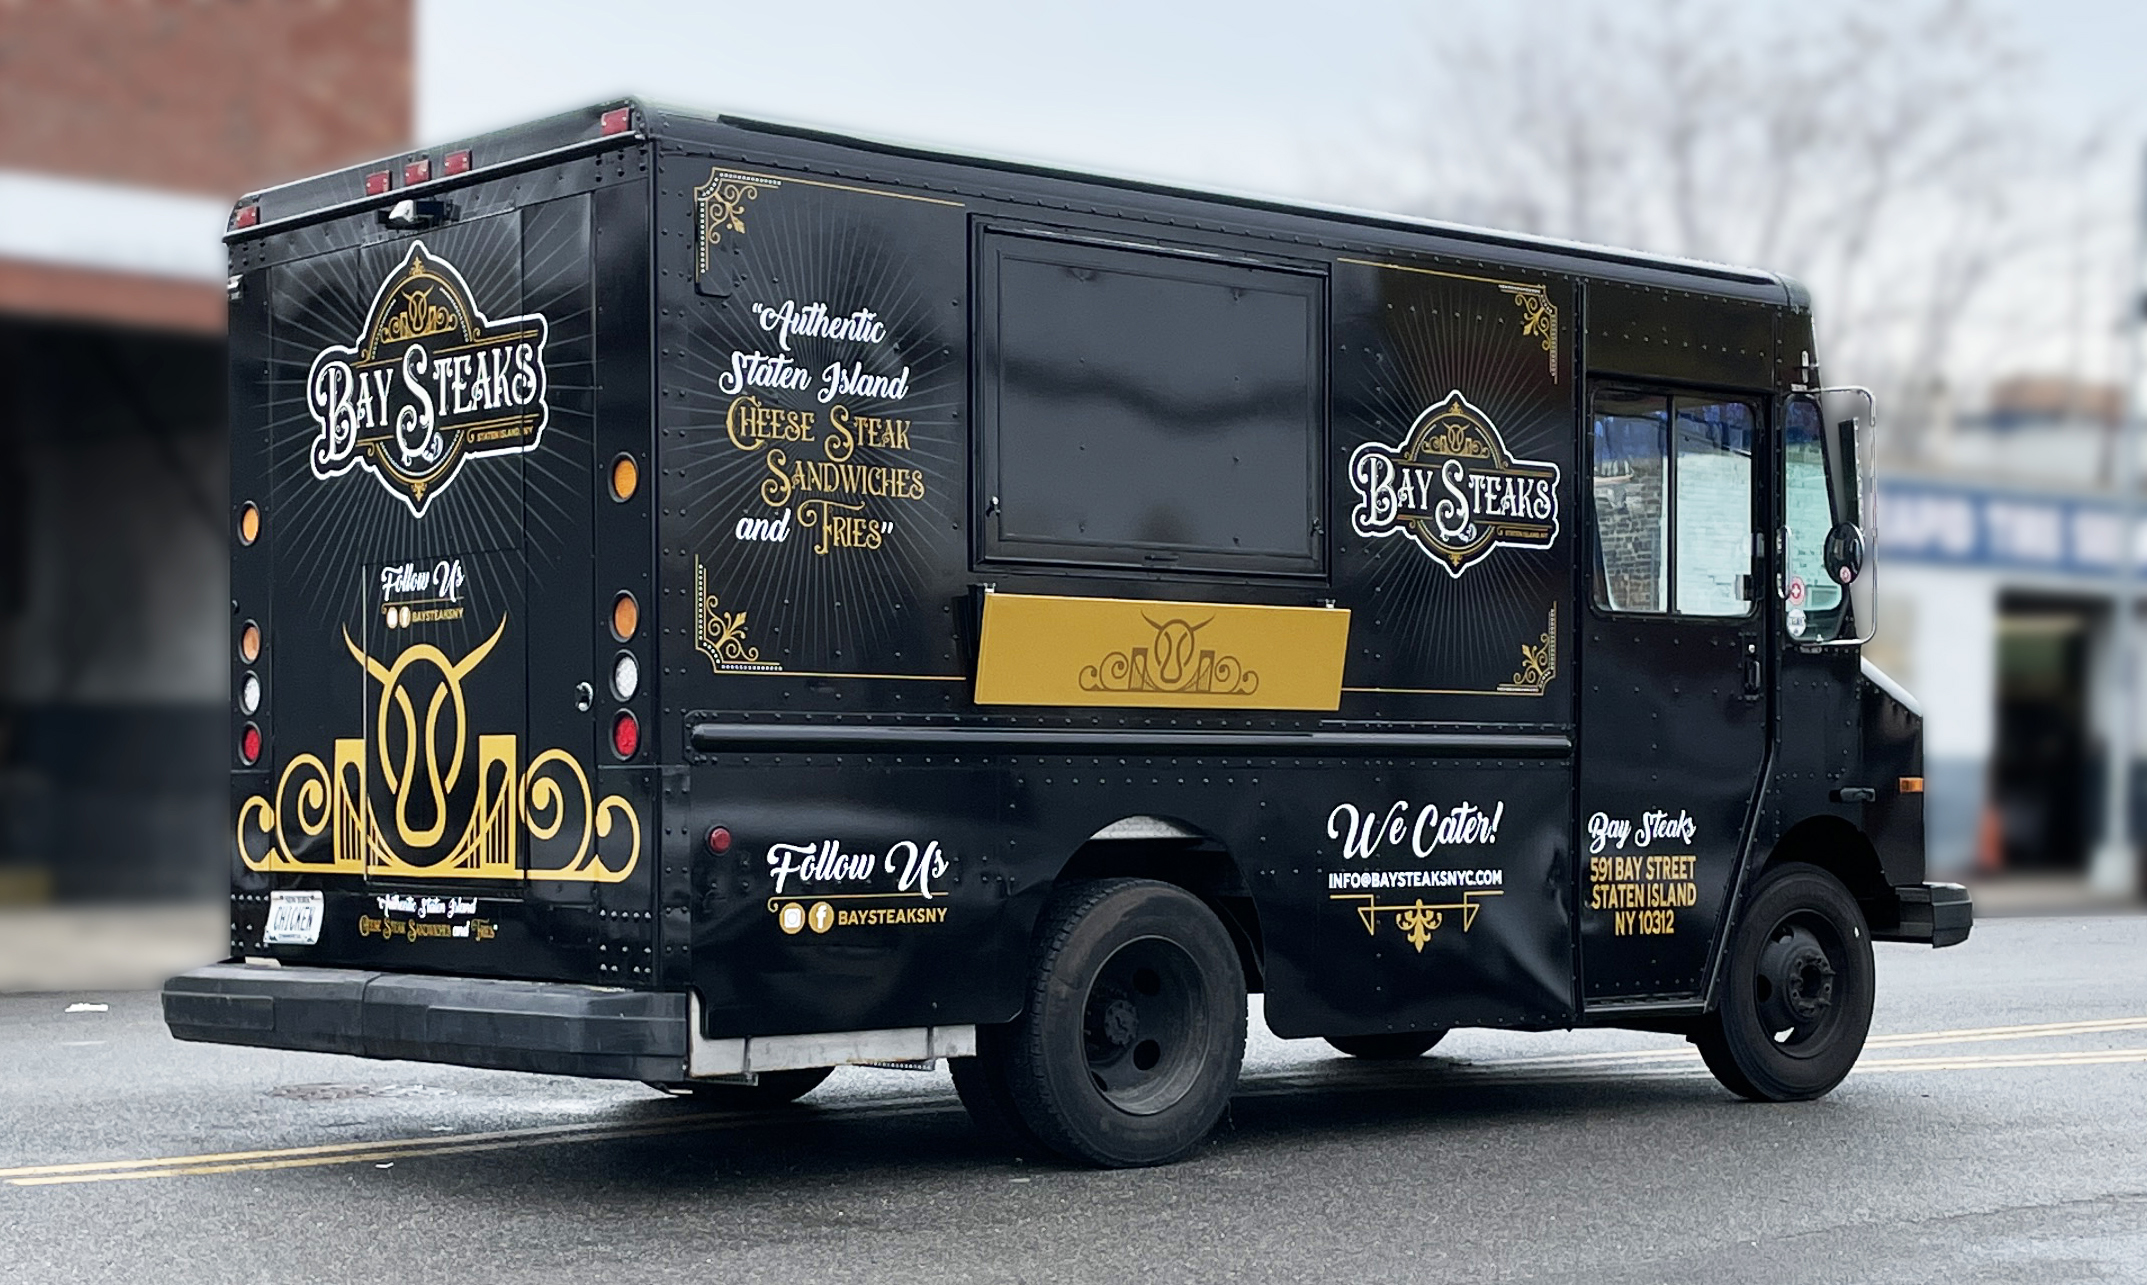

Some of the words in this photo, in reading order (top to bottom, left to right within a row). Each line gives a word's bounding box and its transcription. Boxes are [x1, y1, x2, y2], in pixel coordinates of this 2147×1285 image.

[752, 300, 886, 351] “Authentic
[719, 351, 812, 395] Staten
[817, 361, 910, 404] Island
[315, 360, 394, 463] BAY
[396, 343, 538, 464] STEAKS
[726, 395, 815, 450] CHEESE
[824, 404, 911, 462] STEAK
[761, 449, 925, 507] SANDWICHES
[1356, 453, 1433, 527] BAY
[1435, 459, 1551, 539] STEAKS
[736, 508, 791, 542] and
[381, 563, 430, 601] Follow
[433, 559, 465, 602] Us
[1327, 800, 1409, 859] We
[1412, 801, 1504, 858] Cater!
[1588, 811, 1632, 854] Bay
[1634, 810, 1696, 847] Steaks
[766, 839, 875, 894] Follow
[884, 840, 949, 899] Us
[1328, 870, 1503, 889] INFO@BAYSTEAKSNYC.COM
[1590, 857, 1612, 882] 591
[1615, 856, 1643, 881] BAY
[1645, 855, 1696, 880] STREET
[838, 907, 948, 926] BAYSTEAKSNY
[1592, 883, 1644, 909] STATEN
[1647, 882, 1697, 908] ISLAND
[274, 906, 316, 931] CHICKEN
[1615, 910, 1636, 936] NY
[1638, 909, 1675, 935] 10312
